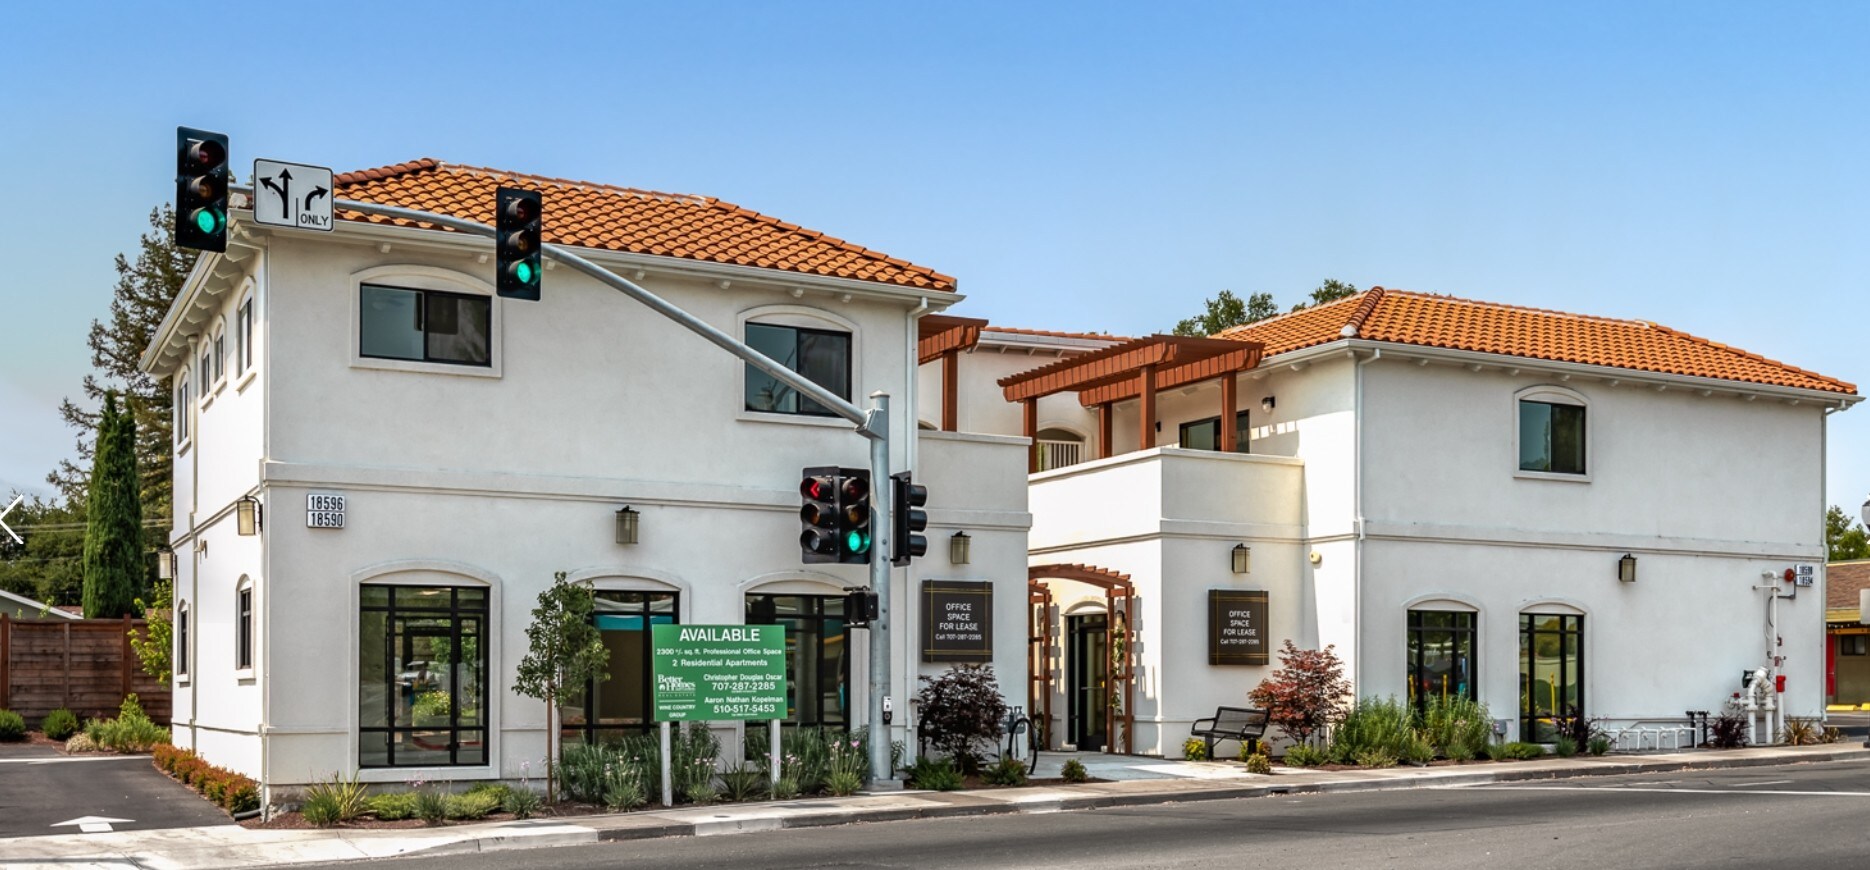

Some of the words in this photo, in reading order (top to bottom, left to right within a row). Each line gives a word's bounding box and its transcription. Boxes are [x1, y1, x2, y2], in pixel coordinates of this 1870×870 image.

[300, 213, 329, 226] ONLY
[311, 496, 342, 510] 18596
[311, 513, 342, 526] 18590
[1229, 610, 1251, 618] OFFICE
[939, 622, 954, 630] FOR
[956, 622, 978, 631] LEASE
[1230, 619, 1250, 627] SPACE
[680, 628, 760, 641] AVAILABLE
[1223, 628, 1236, 636] FOR
[1237, 628, 1256, 637] LEASE
[656, 648, 674, 656] 2300
[703, 648, 741, 656] Professional
[742, 648, 761, 656] Office
[763, 648, 782, 657] Space
[681, 659, 723, 667] Residential
[725, 659, 768, 668] Apartments
[658, 674, 683, 684] Better
[703, 673, 738, 682] Christopher
[740, 673, 763, 682] Douglas
[765, 673, 783, 681] Oscar
[712, 681, 776, 691] 707-287-2285
[704, 696, 725, 704] Aaron
[751, 695, 784, 704] Kopelman
[713, 704, 776, 714] 510-517-5453
